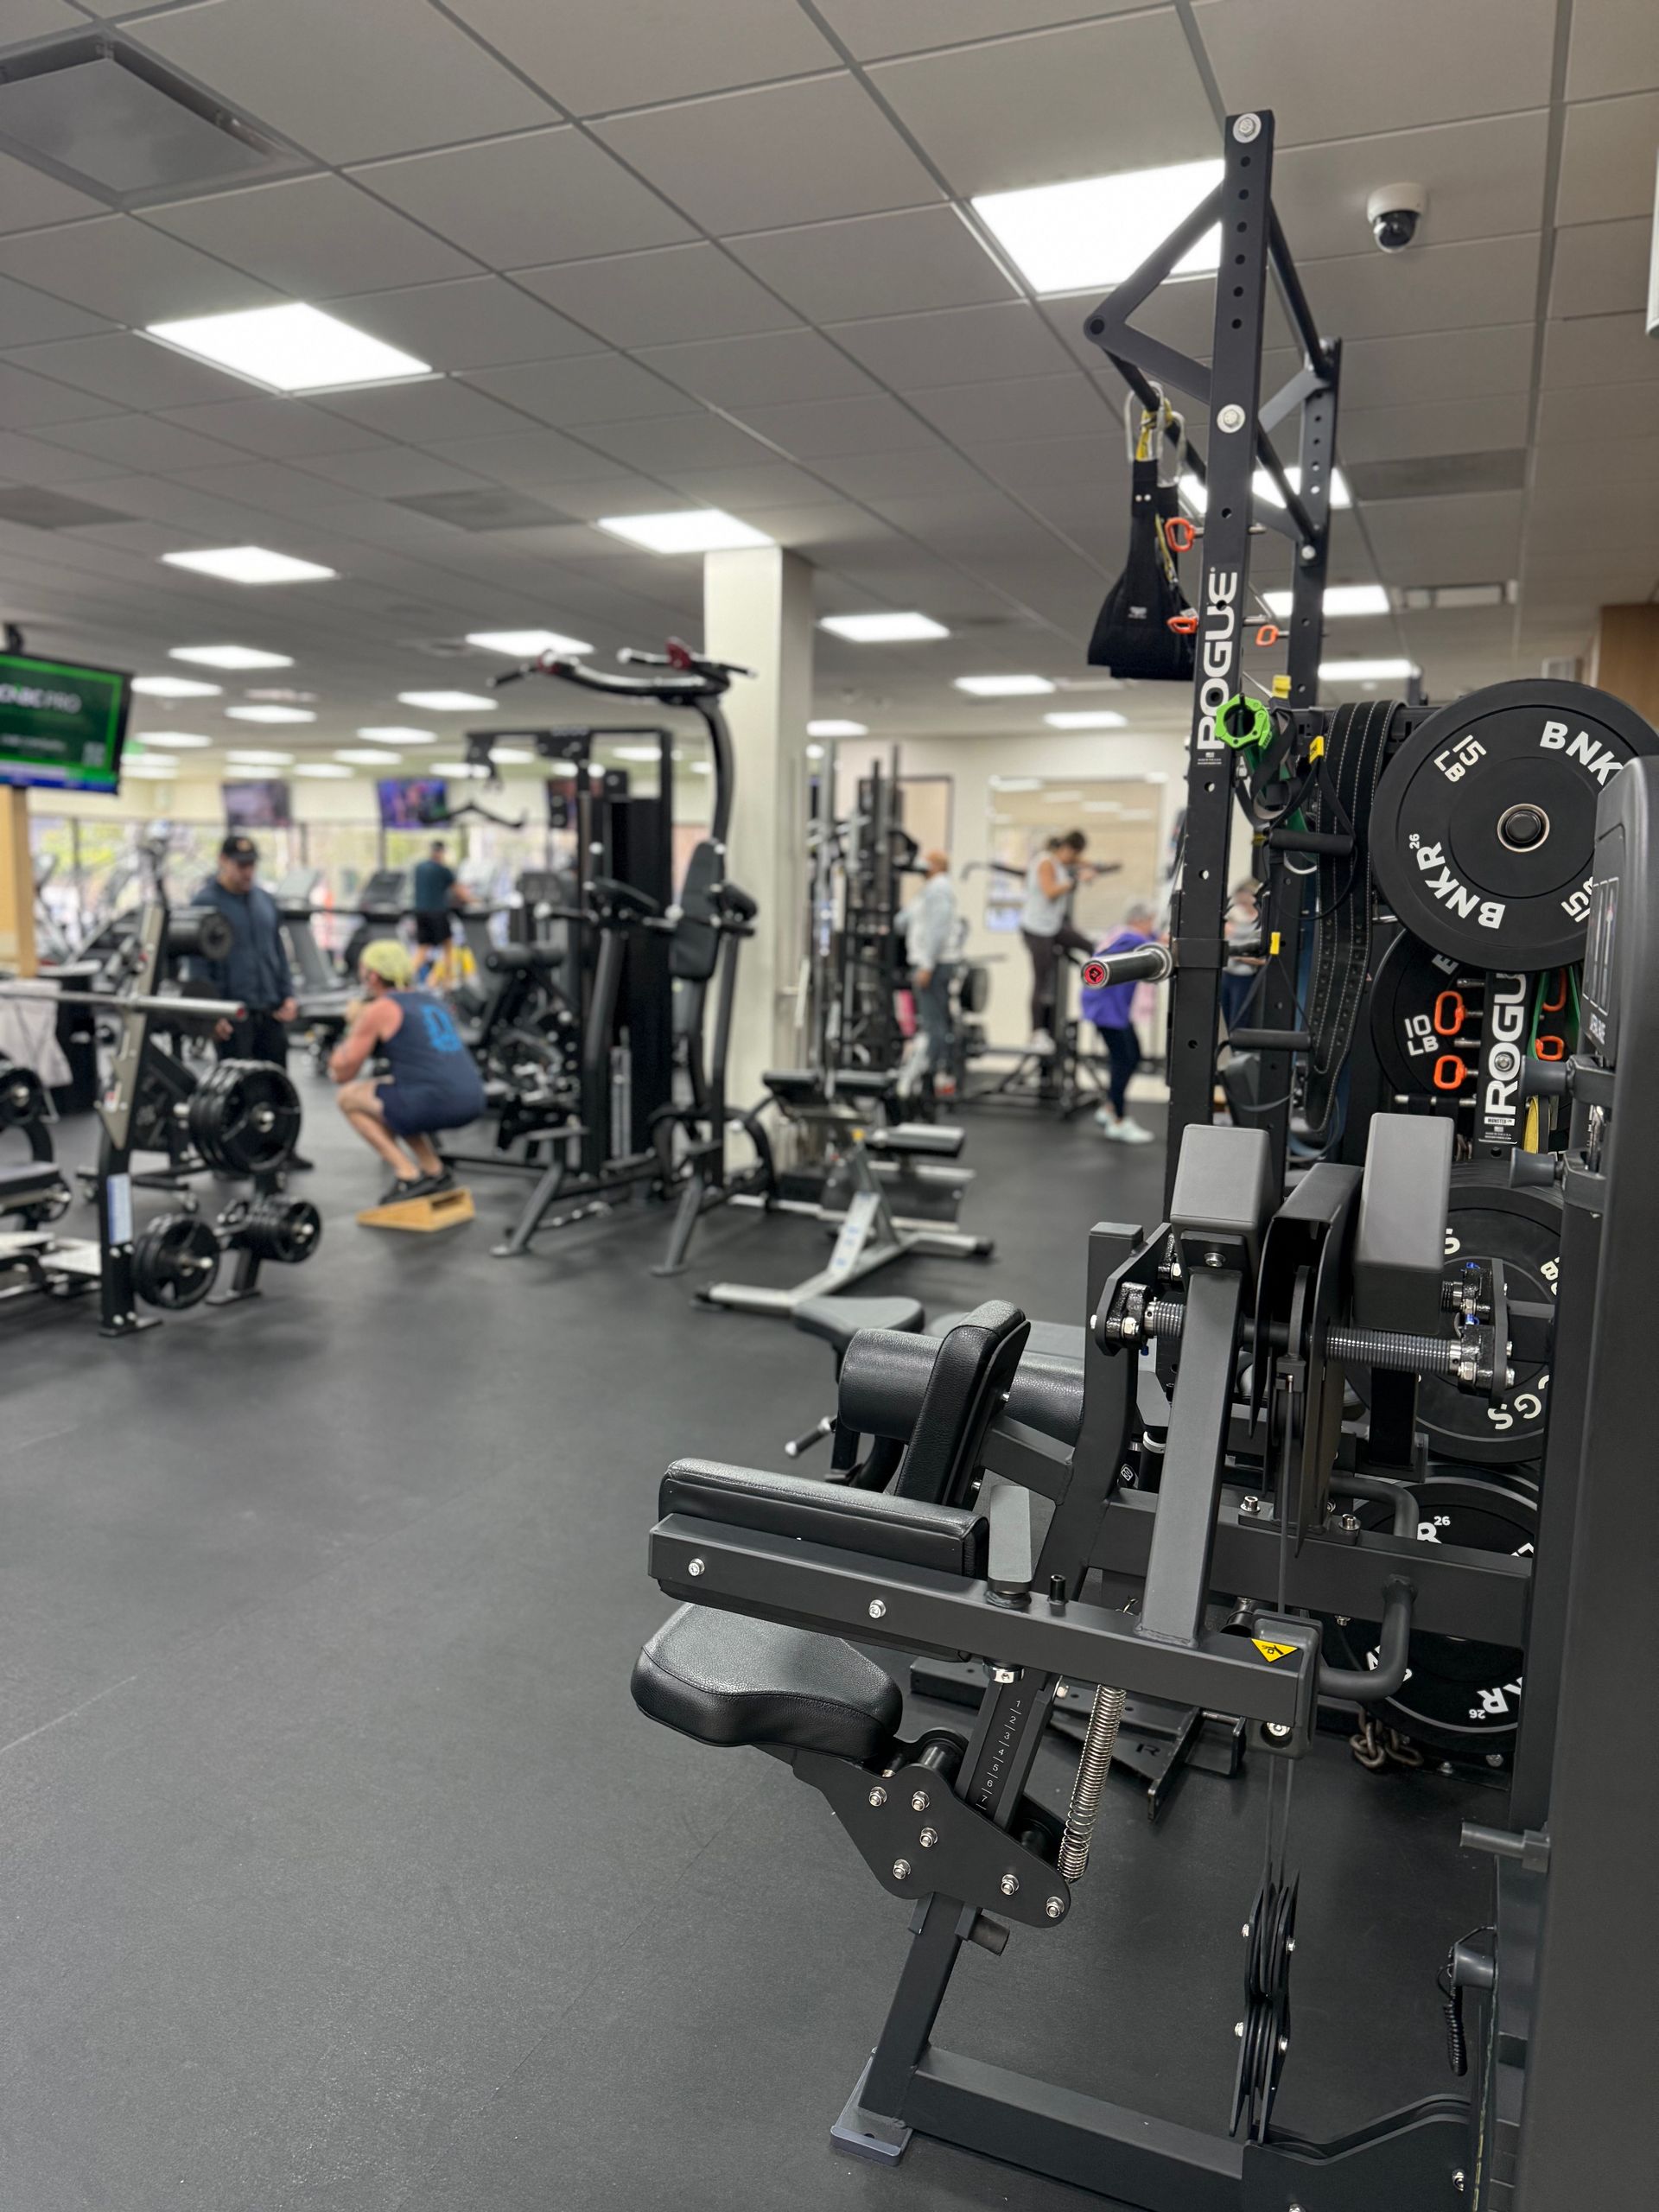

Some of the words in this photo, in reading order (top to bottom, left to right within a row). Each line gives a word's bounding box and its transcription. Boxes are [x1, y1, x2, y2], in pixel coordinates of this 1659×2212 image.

[1452, 734, 1487, 766] 15
[1540, 721, 1624, 785] BNK
[1433, 750, 1466, 782] LB
[1416, 842, 1506, 929] BNKR
[1404, 1014, 1432, 1039] 10
[1407, 1035, 1440, 1057] LB
[1484, 972, 1527, 1116] ROGU
[1009, 1715, 1017, 1725] 2
[1003, 1732, 1010, 1740] 3
[992, 1764, 999, 1772] 5
[987, 1779, 993, 1788] 6
